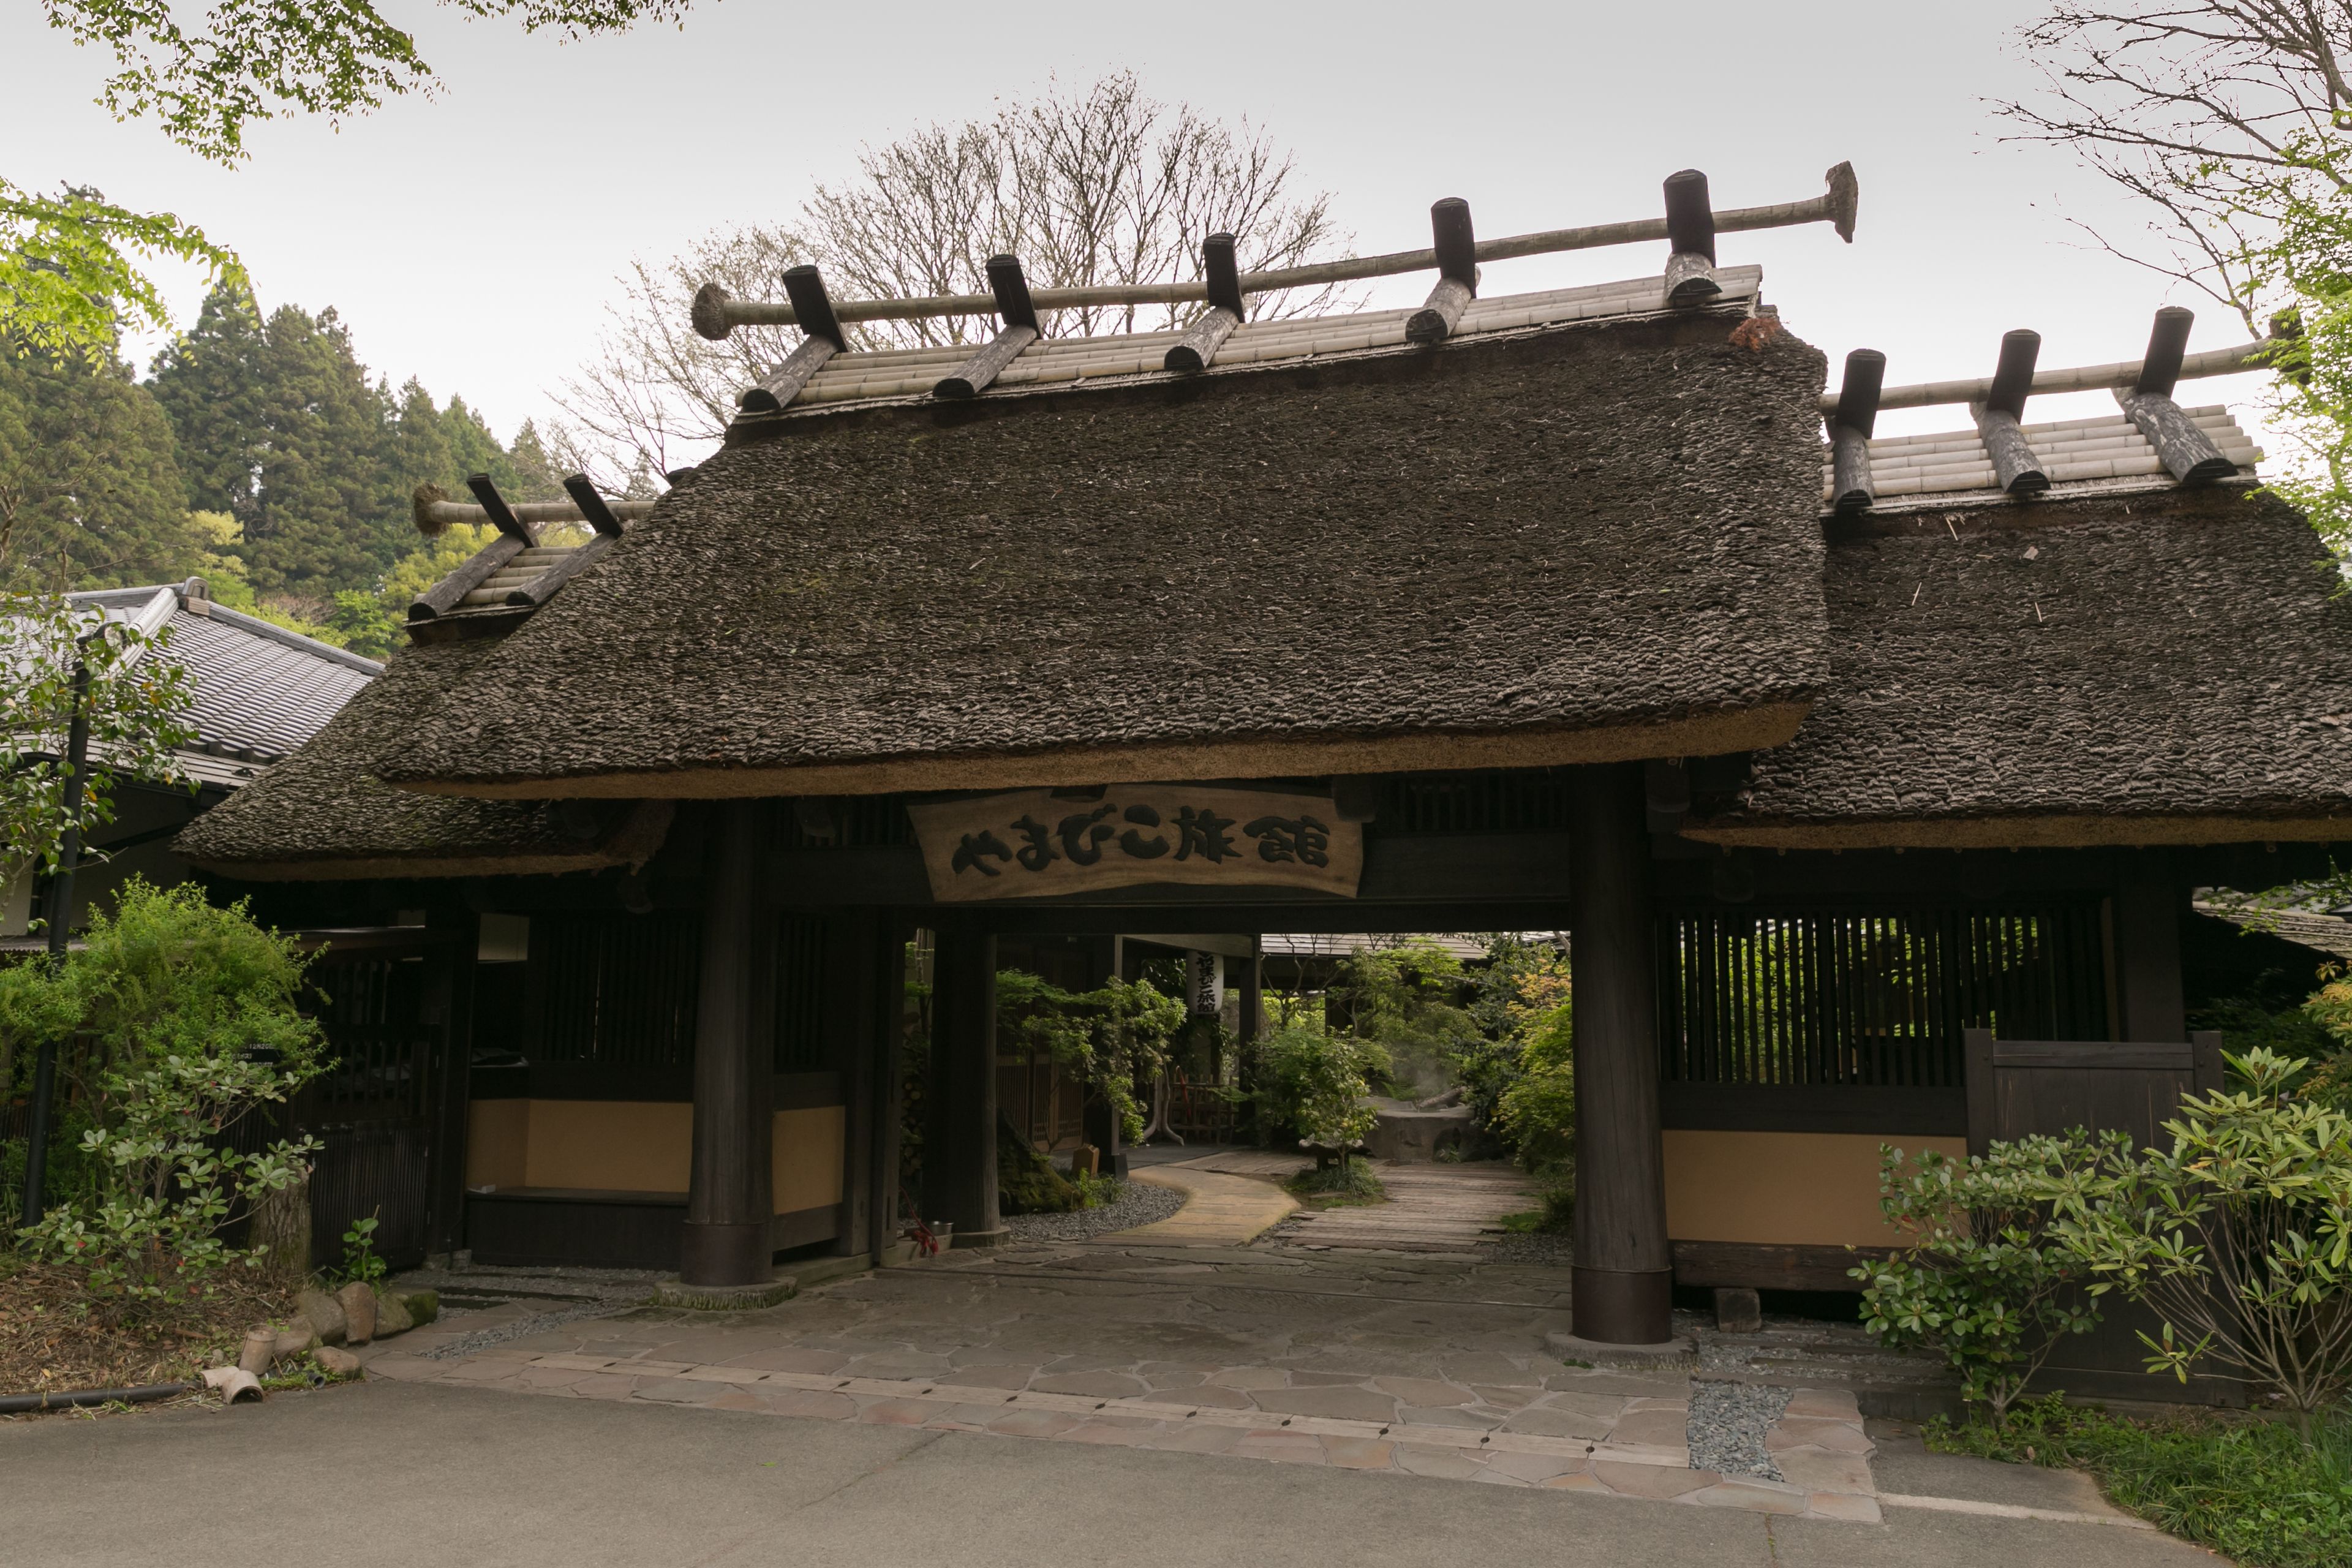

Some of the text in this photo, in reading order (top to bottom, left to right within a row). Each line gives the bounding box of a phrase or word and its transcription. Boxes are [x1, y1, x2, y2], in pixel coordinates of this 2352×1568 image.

[951, 804, 1330, 876] やまびこ旅館
[1196, 956, 1216, 1012] やまびこ旅館
